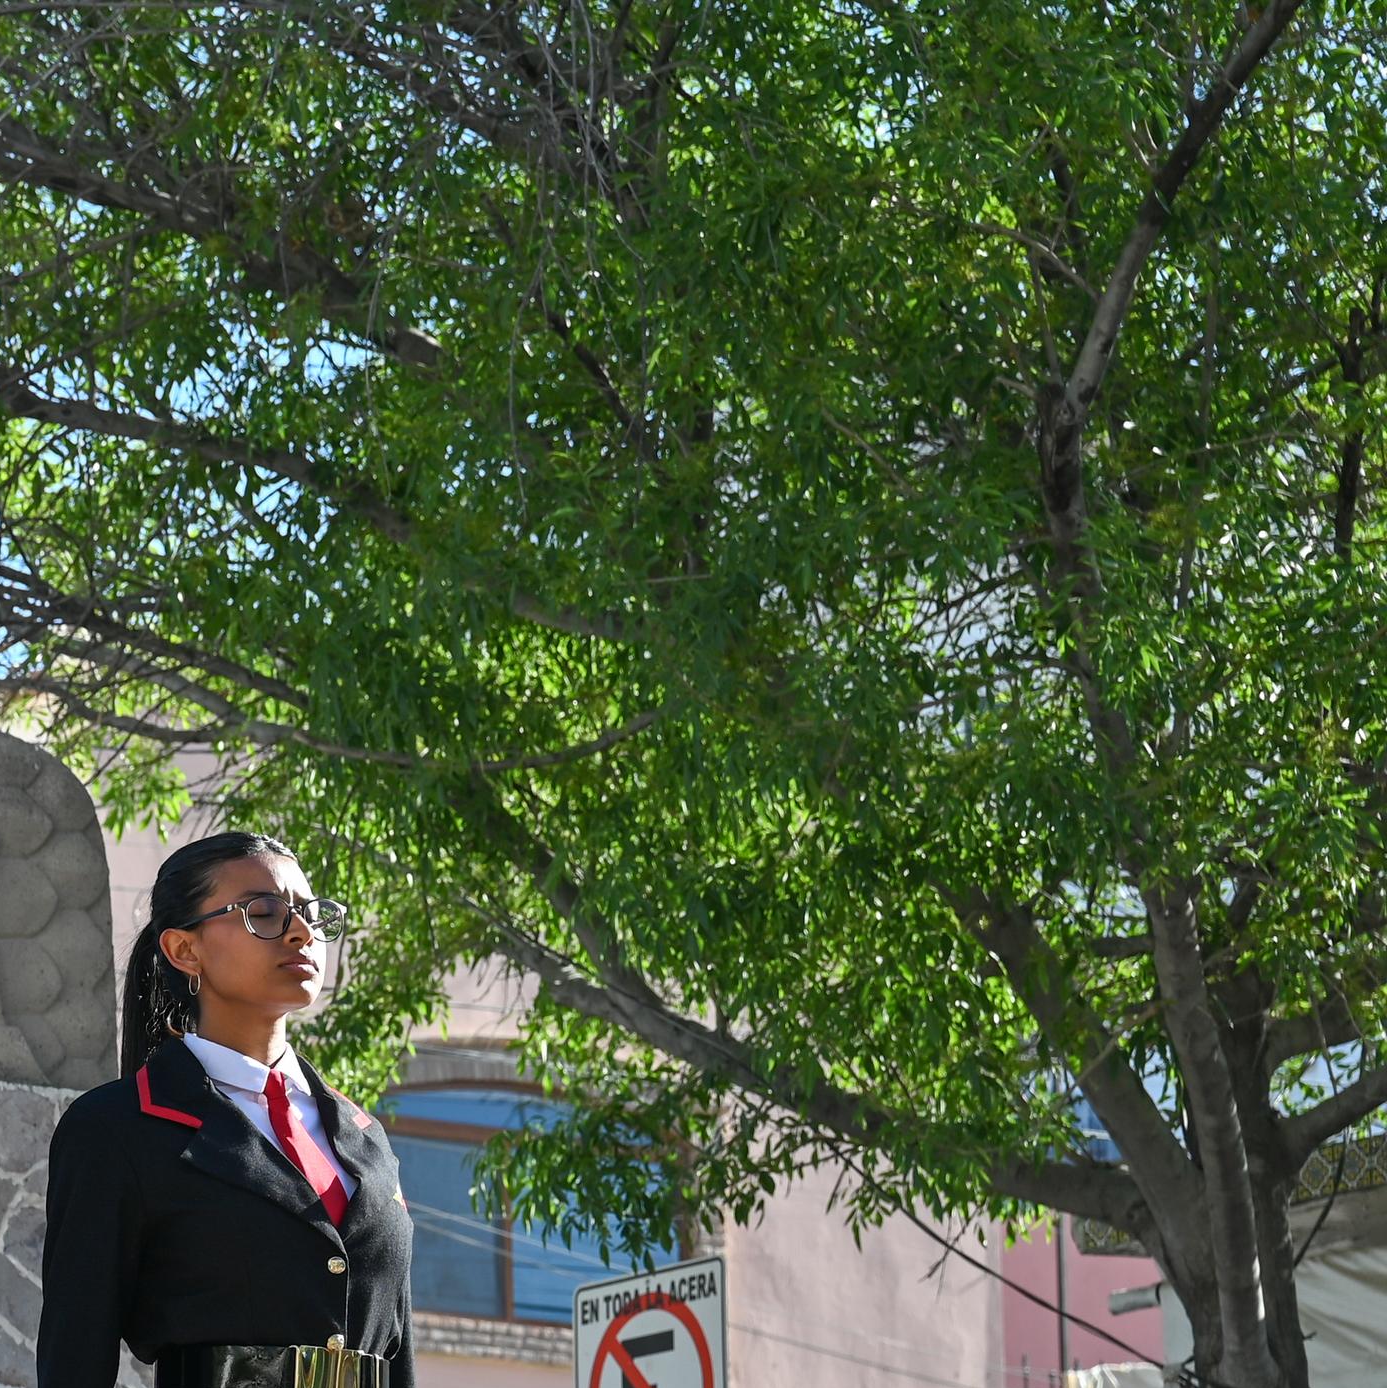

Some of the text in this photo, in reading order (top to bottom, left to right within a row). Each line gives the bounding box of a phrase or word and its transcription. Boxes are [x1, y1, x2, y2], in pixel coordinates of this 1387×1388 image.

[581, 1271, 717, 1325] EN TODA LA ACERA
